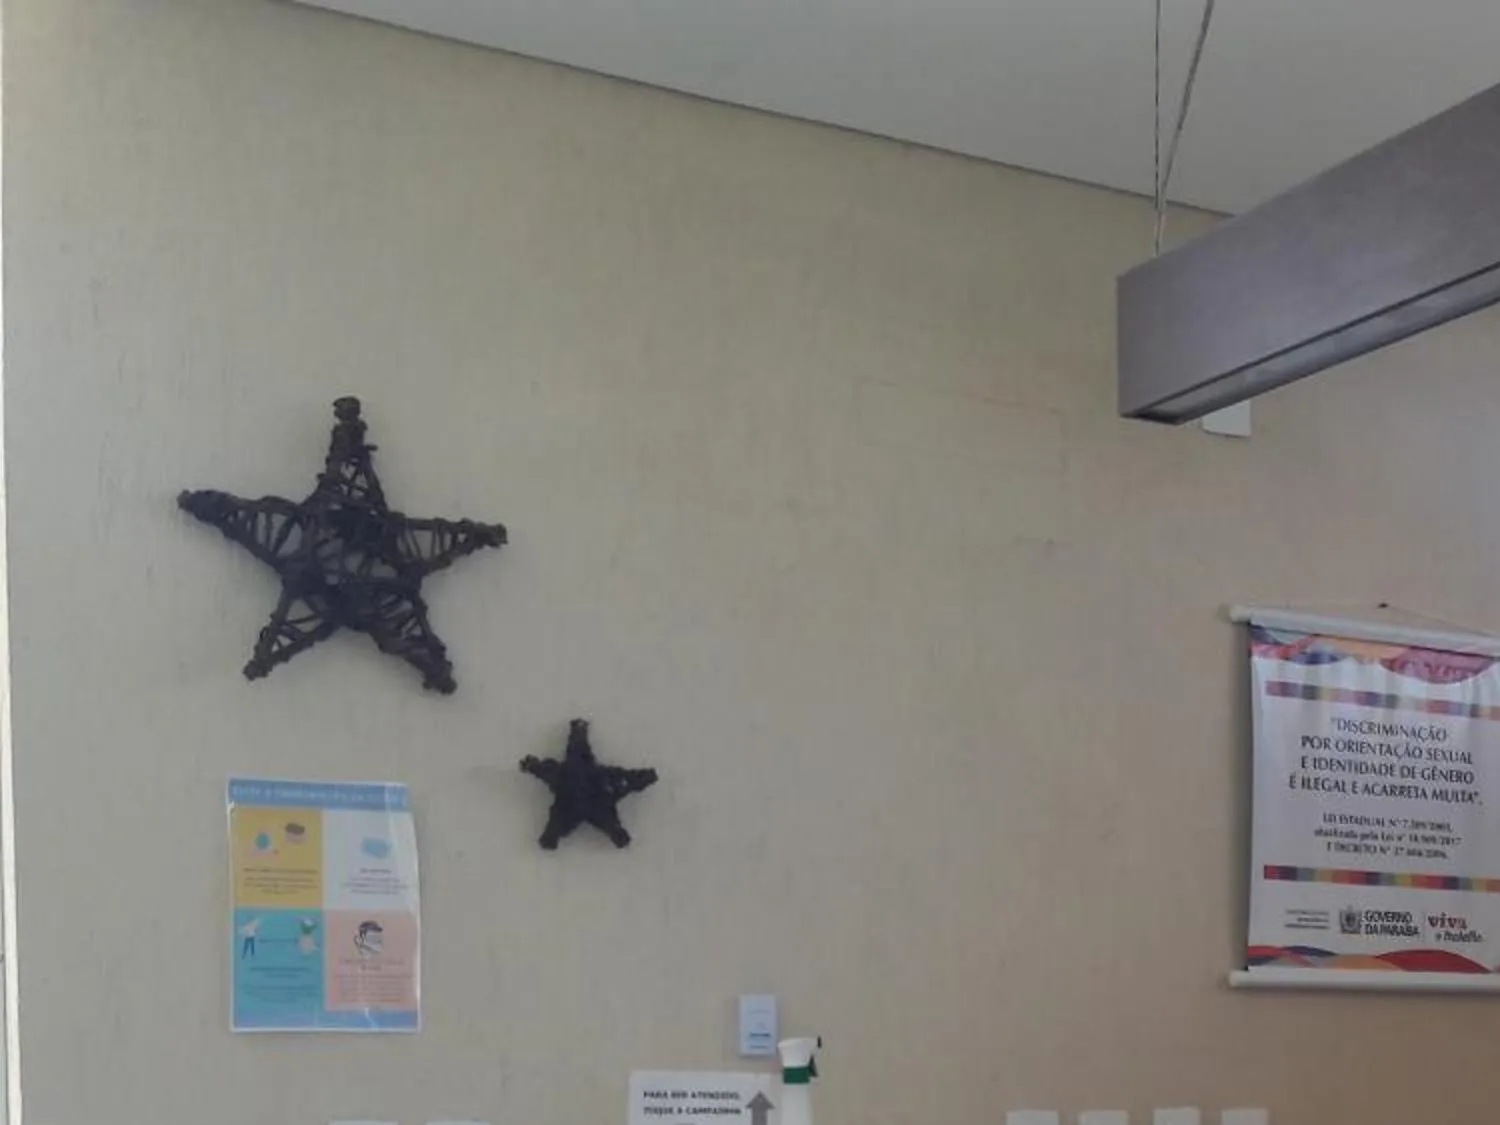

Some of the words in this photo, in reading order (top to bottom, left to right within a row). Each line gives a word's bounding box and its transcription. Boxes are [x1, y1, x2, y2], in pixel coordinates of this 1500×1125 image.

[1301, 735, 1332, 750] POR
[1335, 740, 1423, 760] ORIENTAÇÃO
[1426, 747, 1473, 765] SEXUAL
[1301, 756, 1309, 769] E
[1313, 757, 1396, 778] IDENTIDADE
[1400, 765, 1417, 779] DE
[1421, 765, 1475, 785] GÊNERO
[1289, 771, 1297, 790] É
[1301, 774, 1347, 793] ILEGAL
[1351, 780, 1359, 795] E
[1363, 782, 1428, 801] ACARRETA
[1364, 910, 1413, 923] GOVERNO
[1364, 923, 1379, 935] DA
